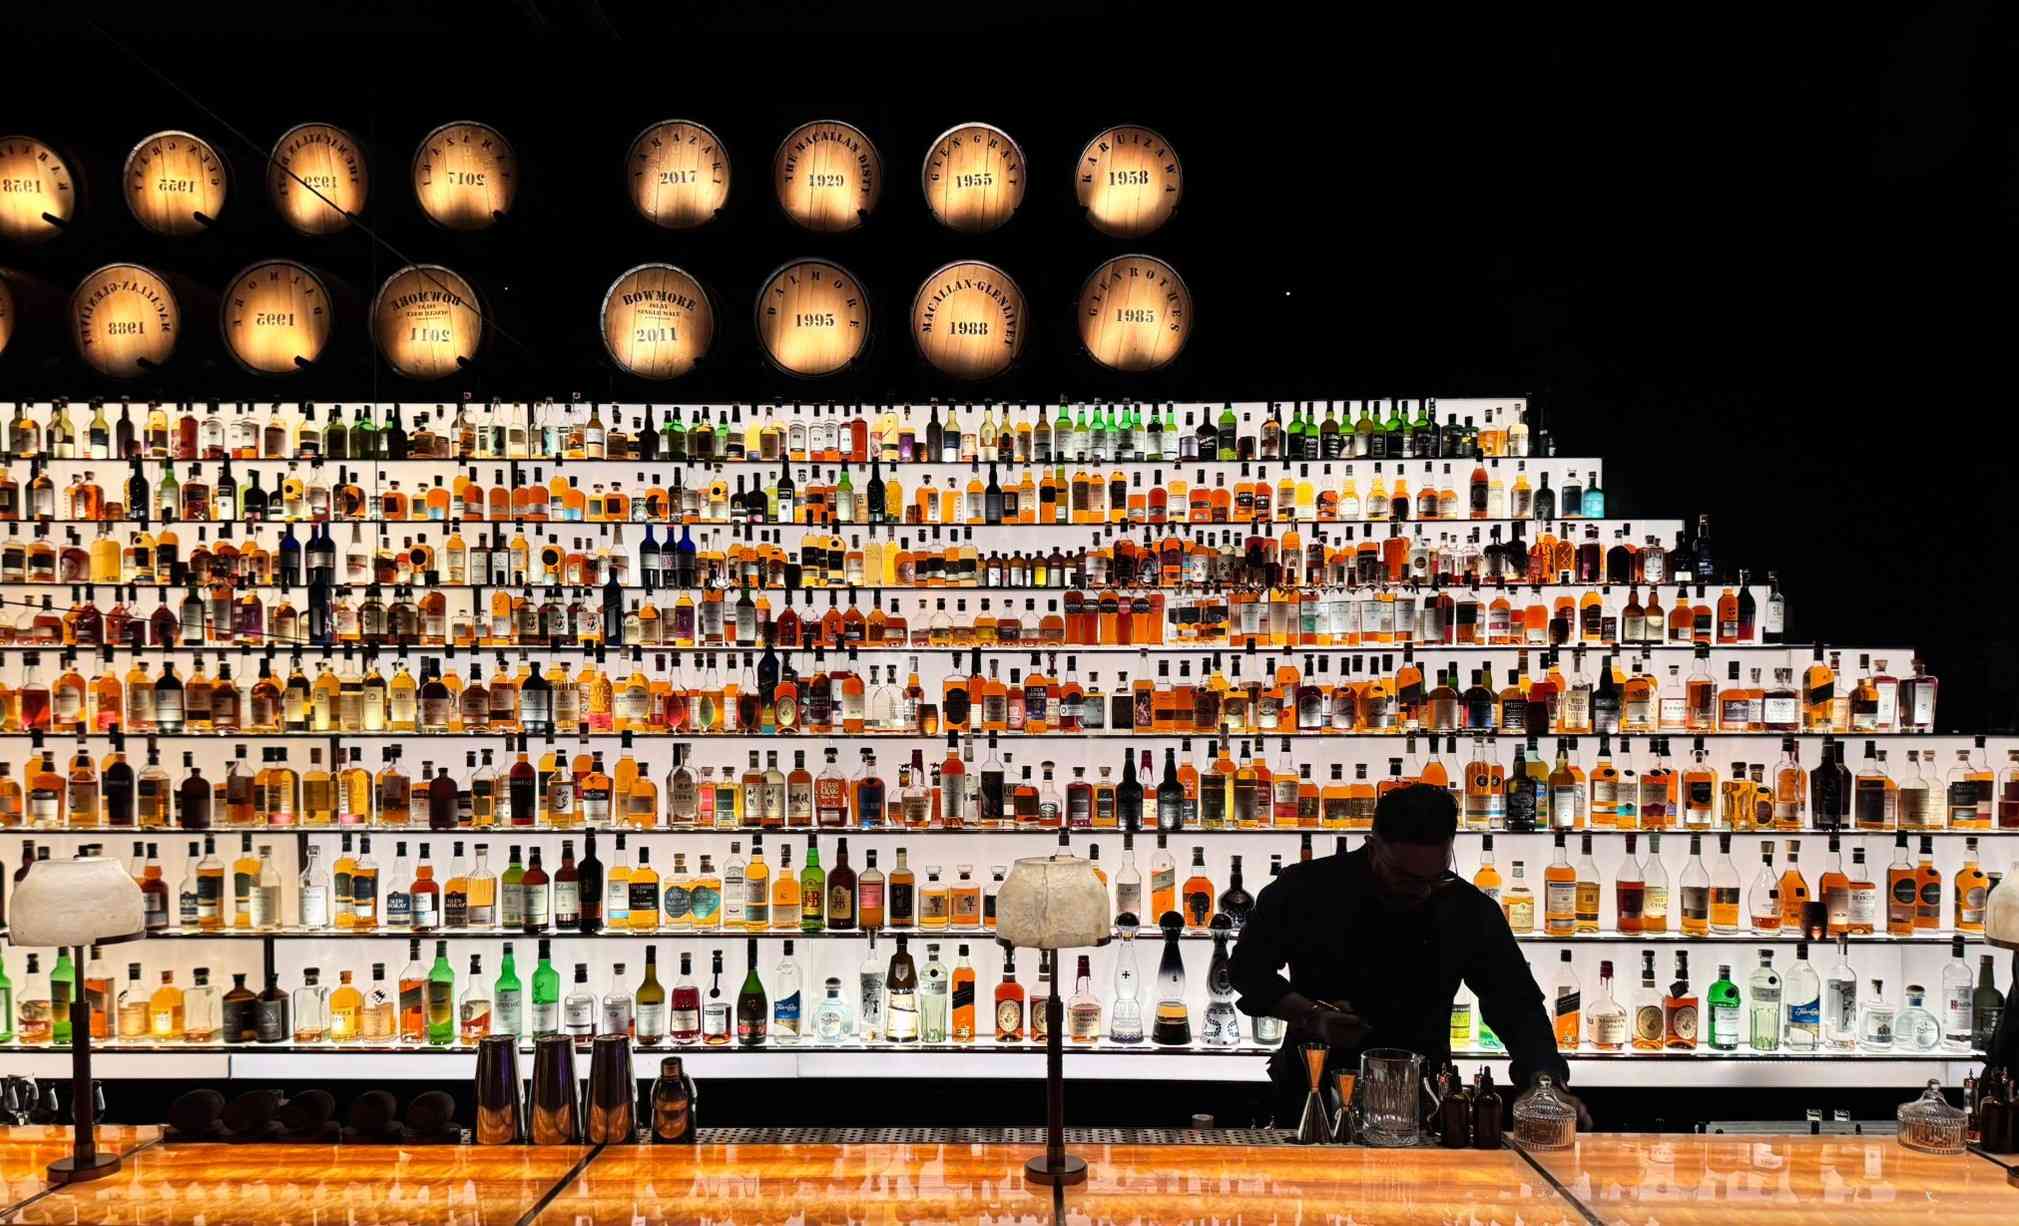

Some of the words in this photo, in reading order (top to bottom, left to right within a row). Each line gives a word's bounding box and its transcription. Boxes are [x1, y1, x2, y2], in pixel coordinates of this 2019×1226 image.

[795, 131, 859, 153] MACALLAN
[930, 137, 962, 181] GLEN
[974, 134, 1018, 186] GRANT
[1082, 134, 1176, 193] KARUIZAWA
[660, 171, 697, 185] 2017
[809, 174, 845, 187] 1929
[956, 173, 993, 188] 1955
[1109, 170, 1149, 186] 1958
[622, 289, 697, 312] BOWMORE
[767, 271, 860, 328] DALMORE
[1088, 267, 1182, 332] GLENROTHES
[796, 313, 834, 327] 1995
[1117, 309, 1155, 323] 1985
[636, 327, 678, 342] 2011
[949, 321, 988, 336] 1988
